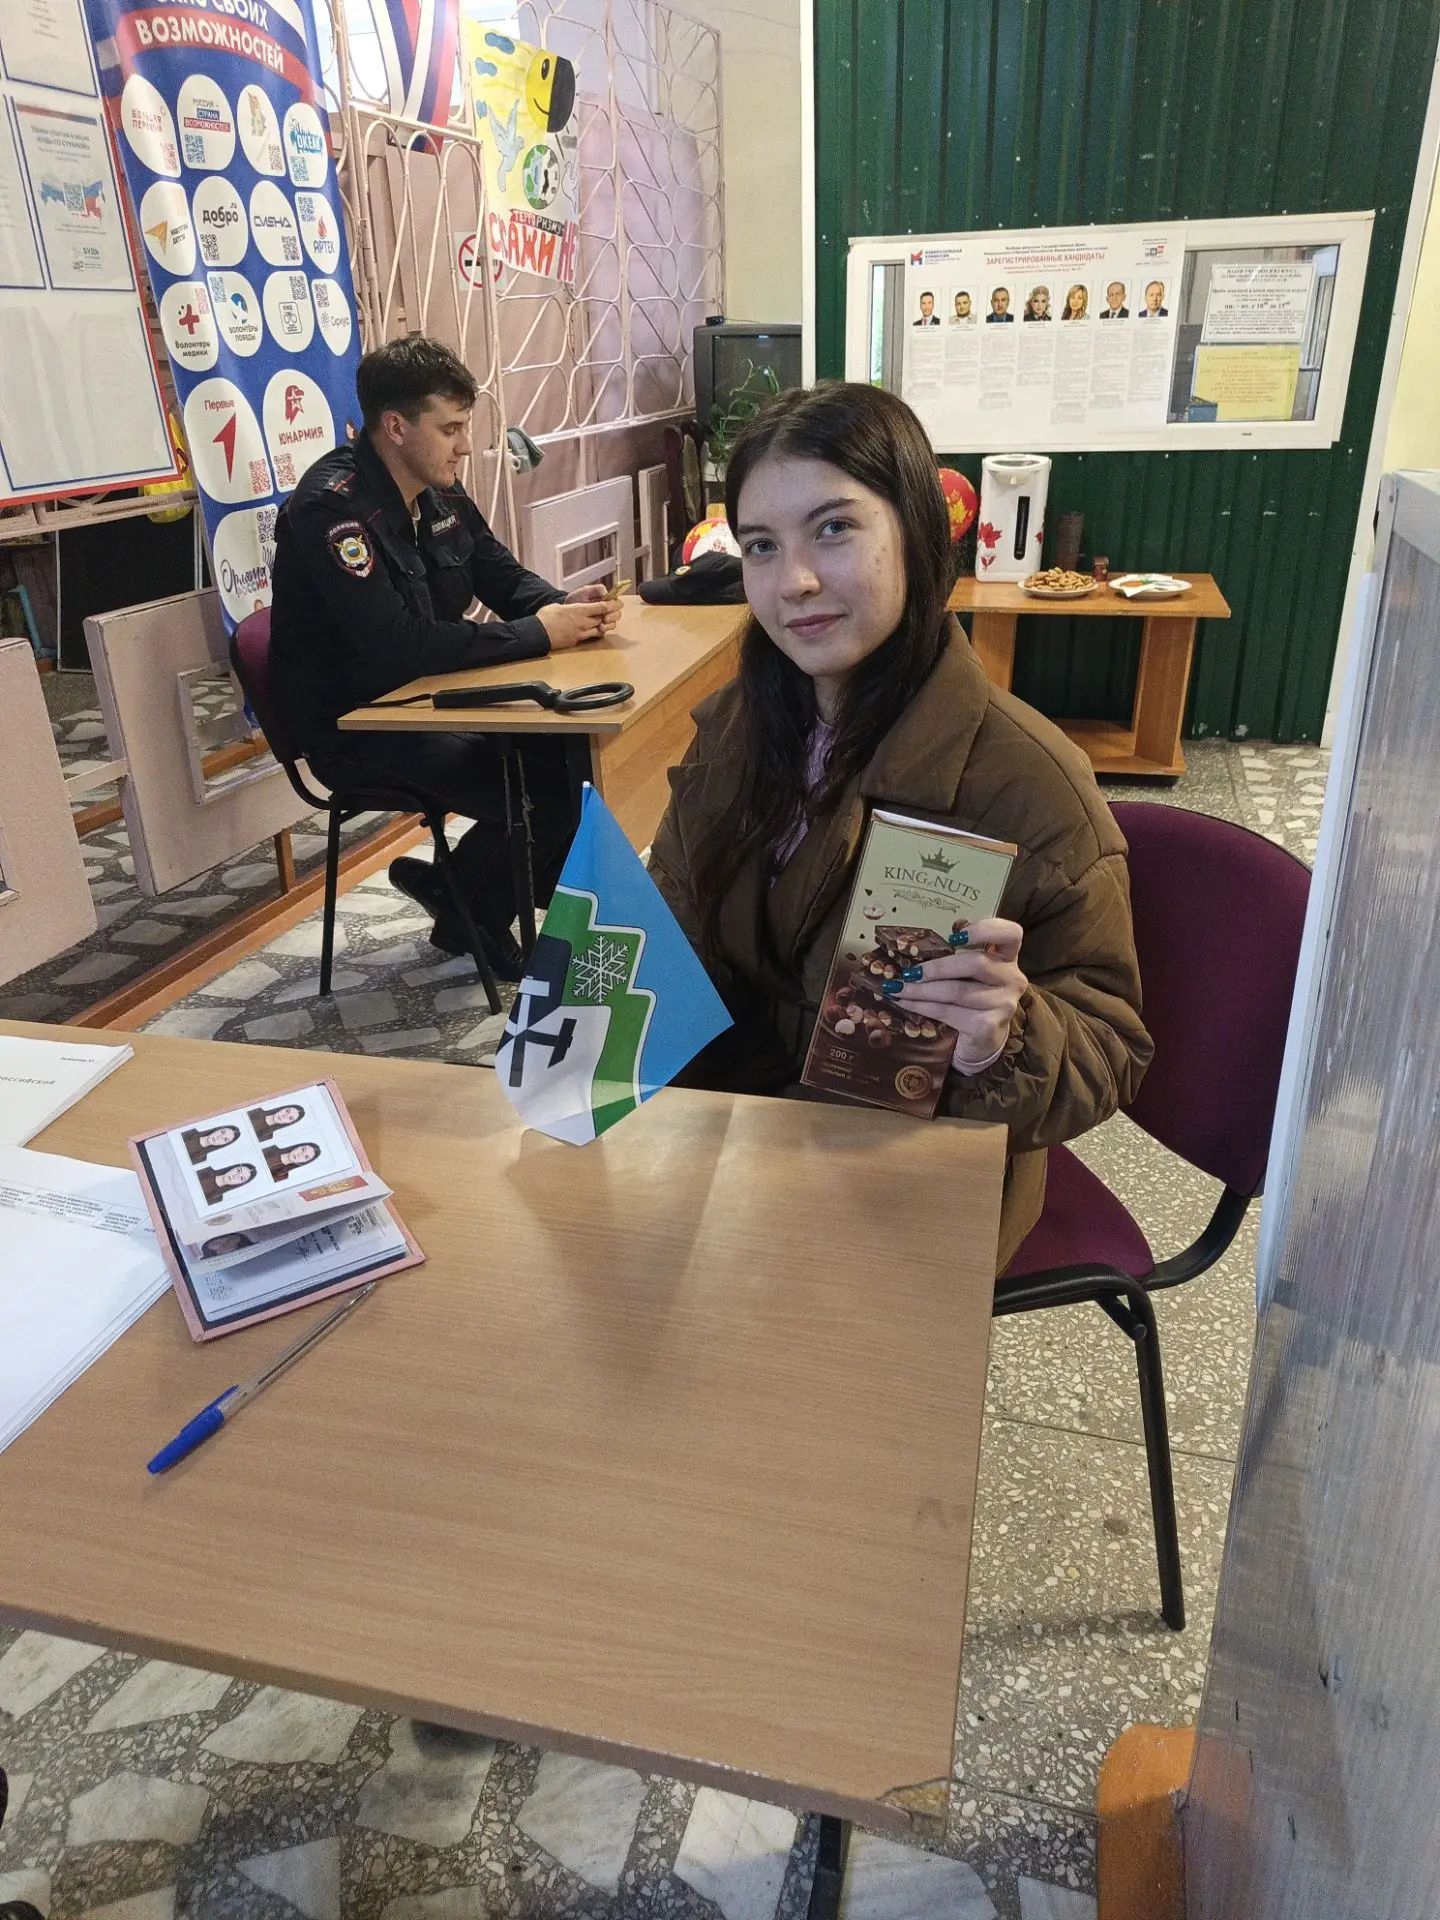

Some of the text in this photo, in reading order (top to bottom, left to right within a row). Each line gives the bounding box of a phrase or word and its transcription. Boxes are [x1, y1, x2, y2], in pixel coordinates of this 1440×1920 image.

[135, 16, 284, 73] ВОЗМОЖНОСТЕЙ
[313, 240, 336, 254] АРТЕК
[1064, 252, 1105, 262] КАНДИДАТЫ
[204, 399, 235, 412] Первые
[278, 426, 324, 446] ЮНАРМИЯ
[329, 522, 360, 537] ПОЛИЦИЯ
[933, 876, 981, 901] NUTS
[829, 1048, 848, 1060] 200
